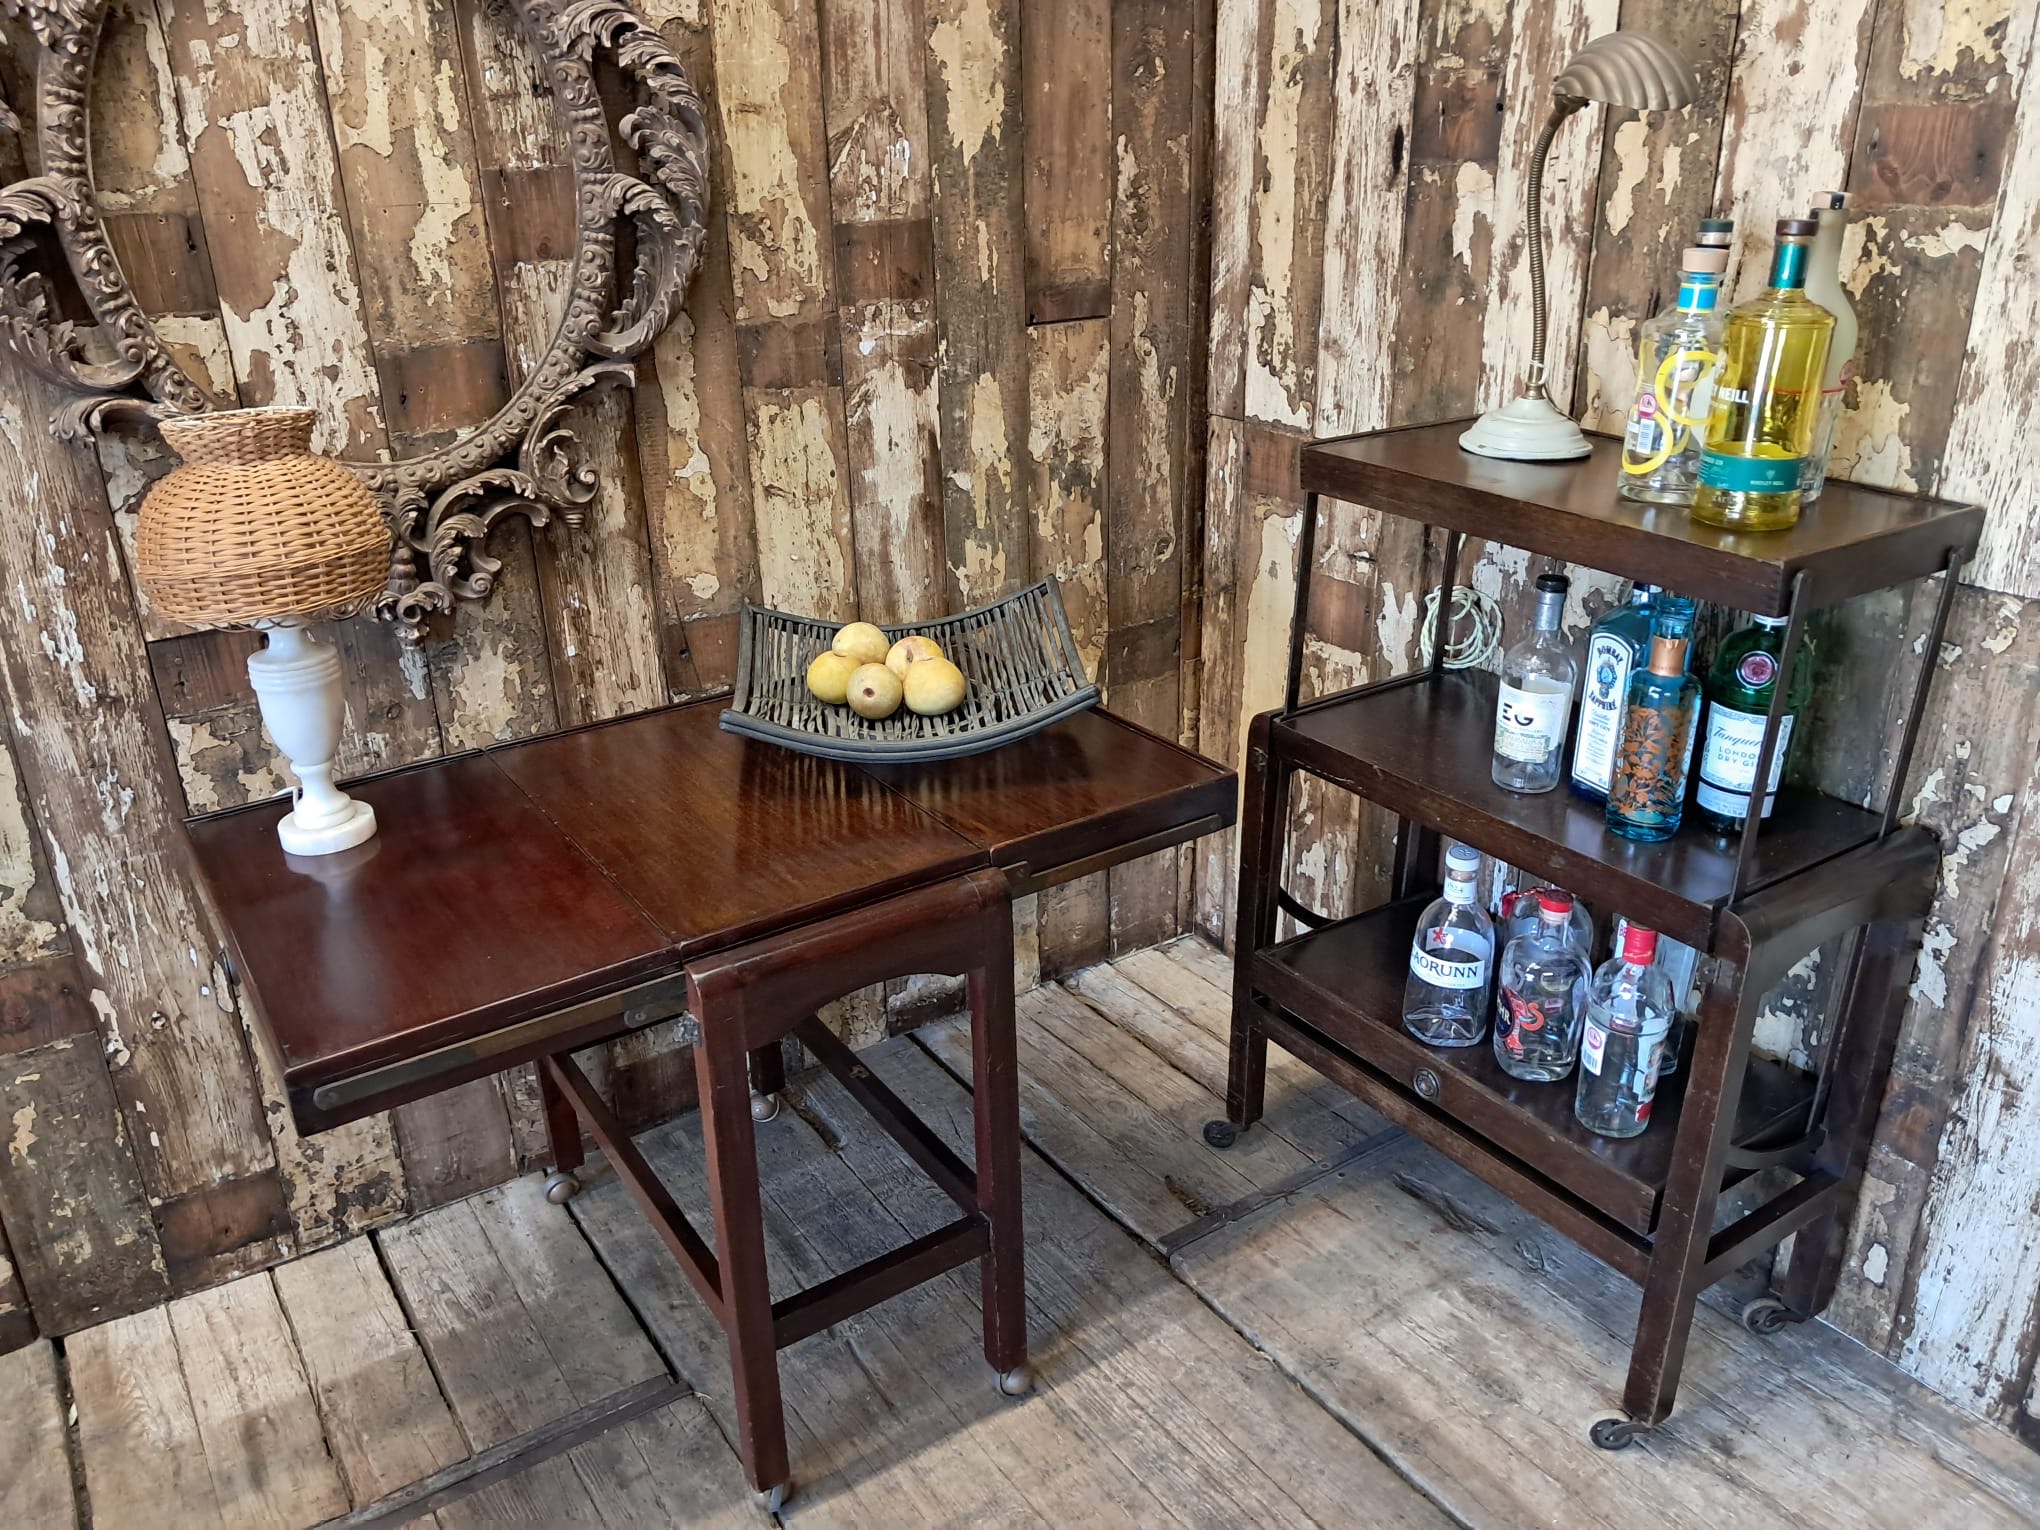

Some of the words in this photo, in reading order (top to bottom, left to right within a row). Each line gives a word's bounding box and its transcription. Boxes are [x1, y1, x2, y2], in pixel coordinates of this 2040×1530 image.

[1597, 645, 1624, 665] BOMBAY
[1588, 690, 1617, 711] SAPPHIRE
[1713, 726, 1762, 746] Tanquer
[1717, 754, 1738, 764] DRY
[1742, 760, 1754, 768] GI
[1719, 746, 1756, 760] LONDO
[1412, 949, 1479, 978] AORUNN
